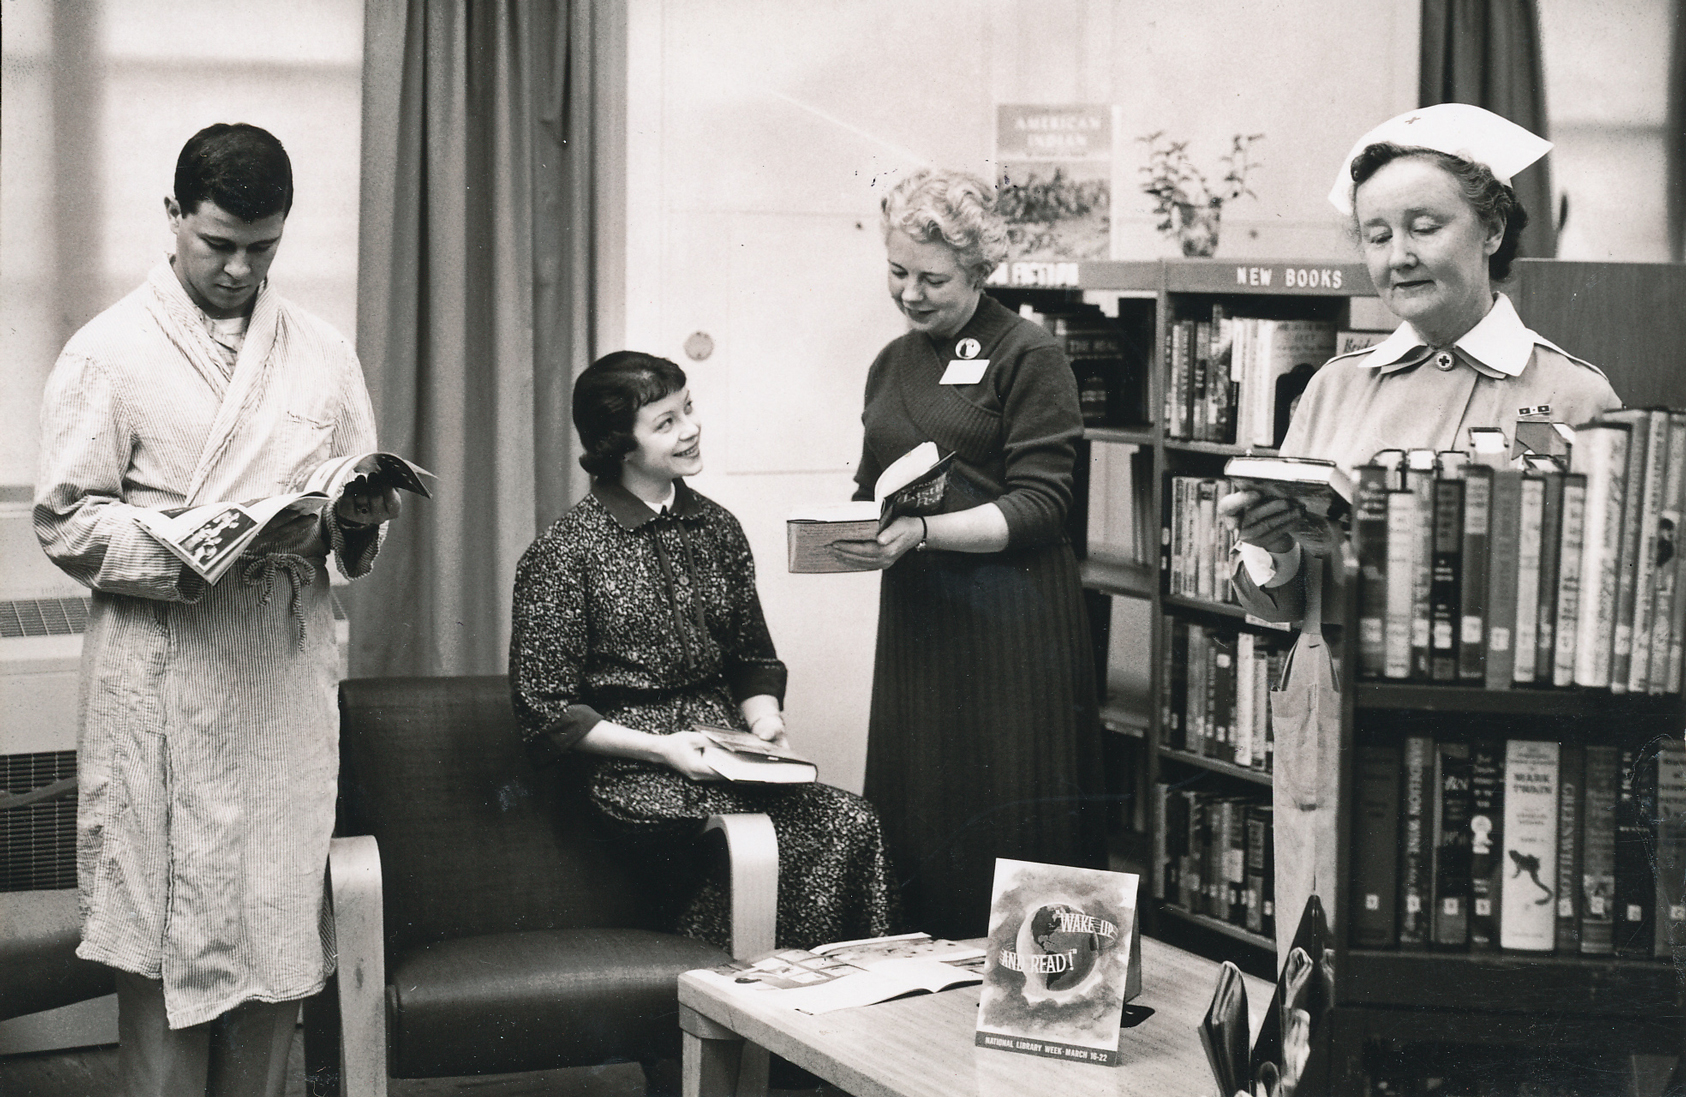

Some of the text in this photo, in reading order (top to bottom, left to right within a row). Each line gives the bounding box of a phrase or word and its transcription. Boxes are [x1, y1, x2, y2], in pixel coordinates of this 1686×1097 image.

[1014, 116, 1101, 131] AMERICAN
[1027, 133, 1087, 148] INDIAN
[1237, 266, 1342, 289] NEW BOOKS
[1514, 773, 1550, 783] MARK
[1513, 784, 1553, 795] TWAIN
[1100, 921, 1114, 936] UP
[1001, 950, 1023, 971] AND
[985, 1036, 1014, 1048] NATIONAL
[1016, 1041, 1042, 1053] LIBRARY
[1090, 1053, 1108, 1062] 16-22
